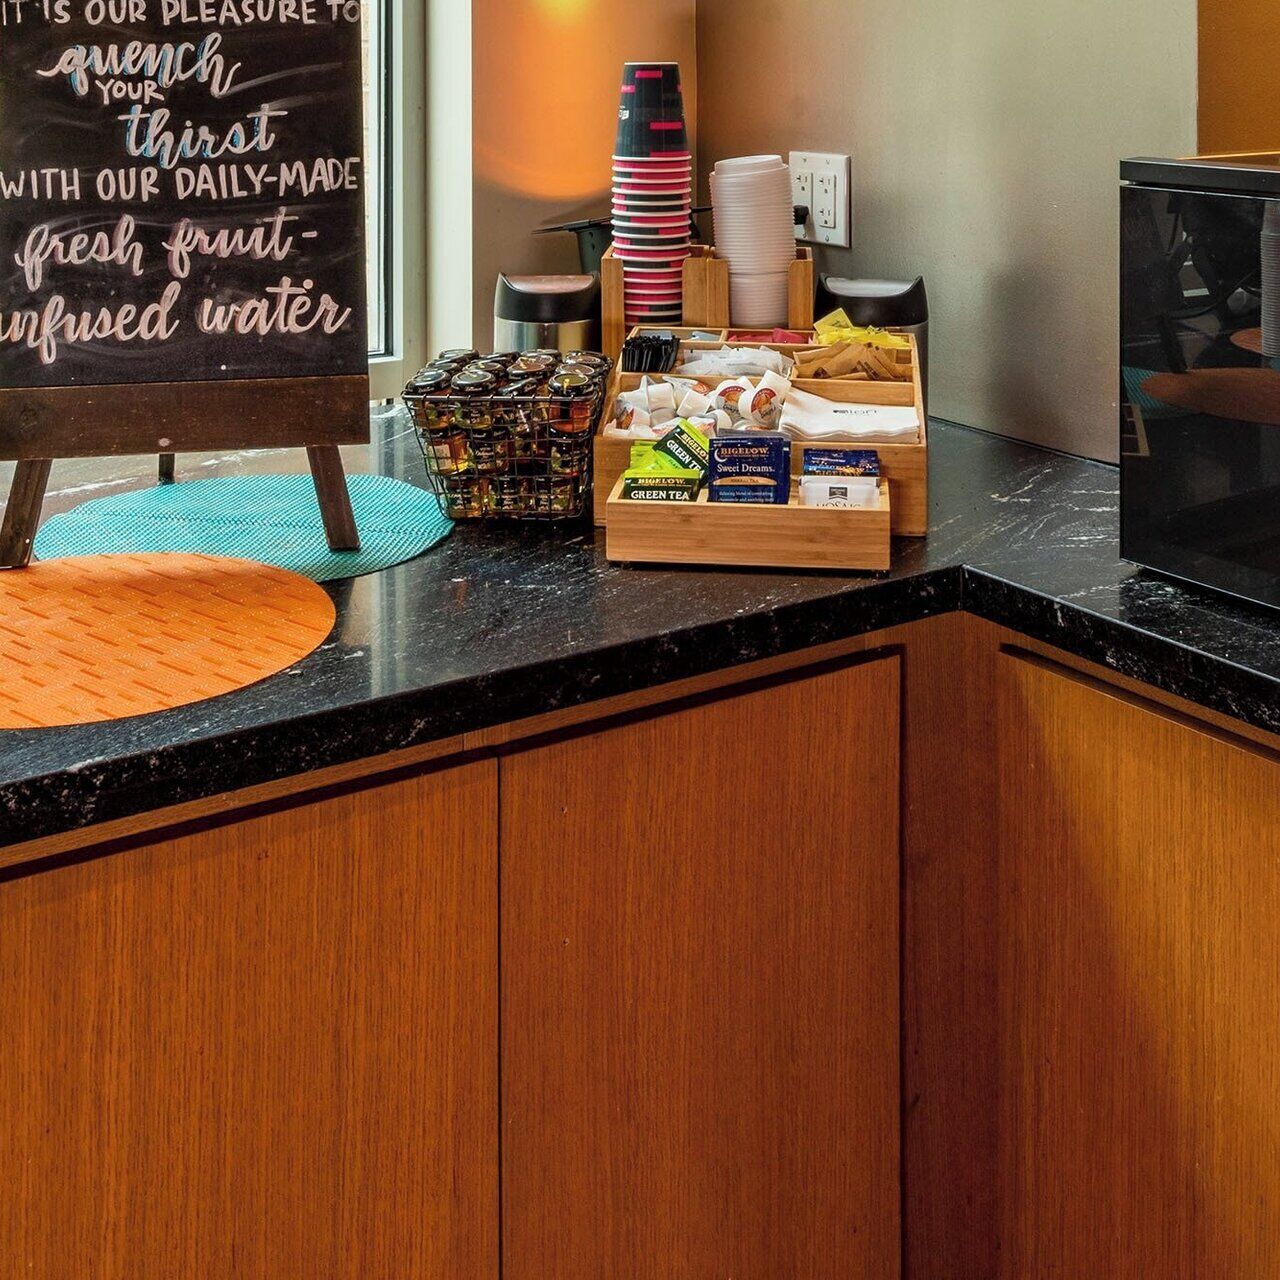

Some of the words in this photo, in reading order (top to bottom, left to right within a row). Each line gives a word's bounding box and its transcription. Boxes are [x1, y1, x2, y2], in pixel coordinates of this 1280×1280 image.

[35, 31, 241, 98] quench
[95, 78, 165, 106] YOUR
[117, 103, 289, 170] thirst
[0, 167, 81, 200] WITH
[96, 165, 160, 202] OUR
[175, 157, 361, 200] DAILY-MADE
[14, 213, 145, 292] fresh
[198, 276, 352, 335] water
[666, 440, 693, 464] GREEN
[717, 463, 740, 472] Sweet
[631, 490, 667, 499] GREEN
[668, 490, 690, 500] TEA
